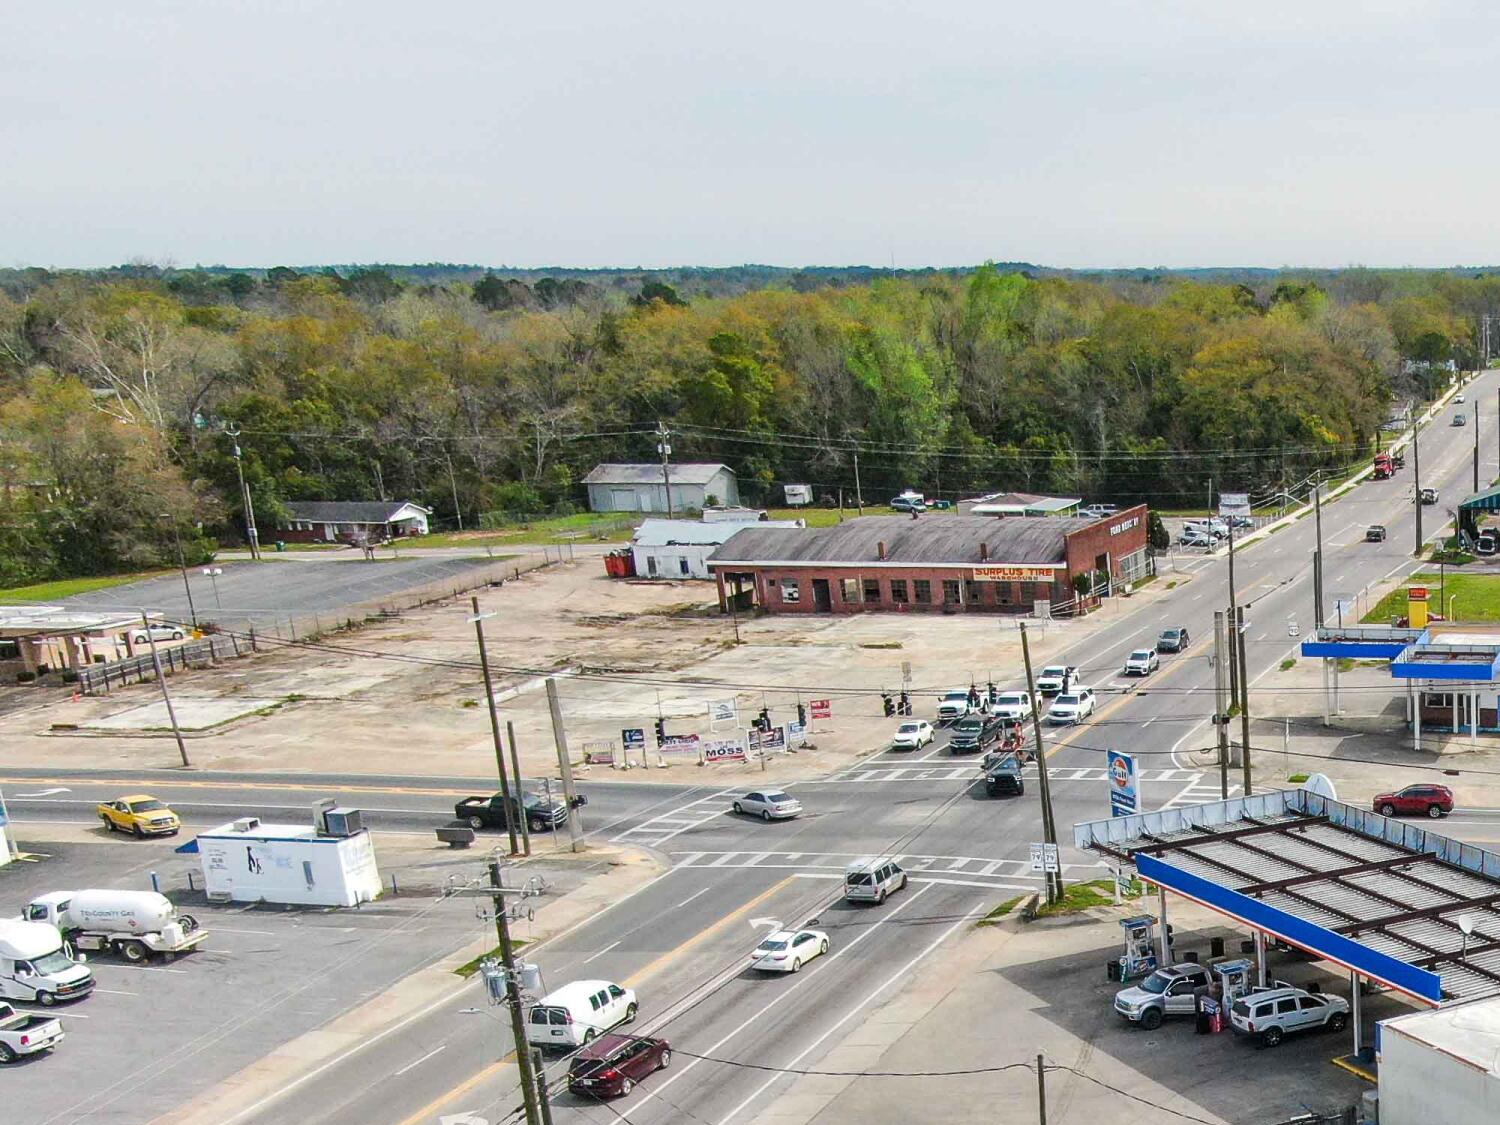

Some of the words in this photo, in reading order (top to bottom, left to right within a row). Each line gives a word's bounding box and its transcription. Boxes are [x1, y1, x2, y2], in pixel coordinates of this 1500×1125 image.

[975, 568, 1024, 576] SURPLUS
[1027, 568, 1053, 576] TIRE
[706, 747, 743, 756] MOSS
